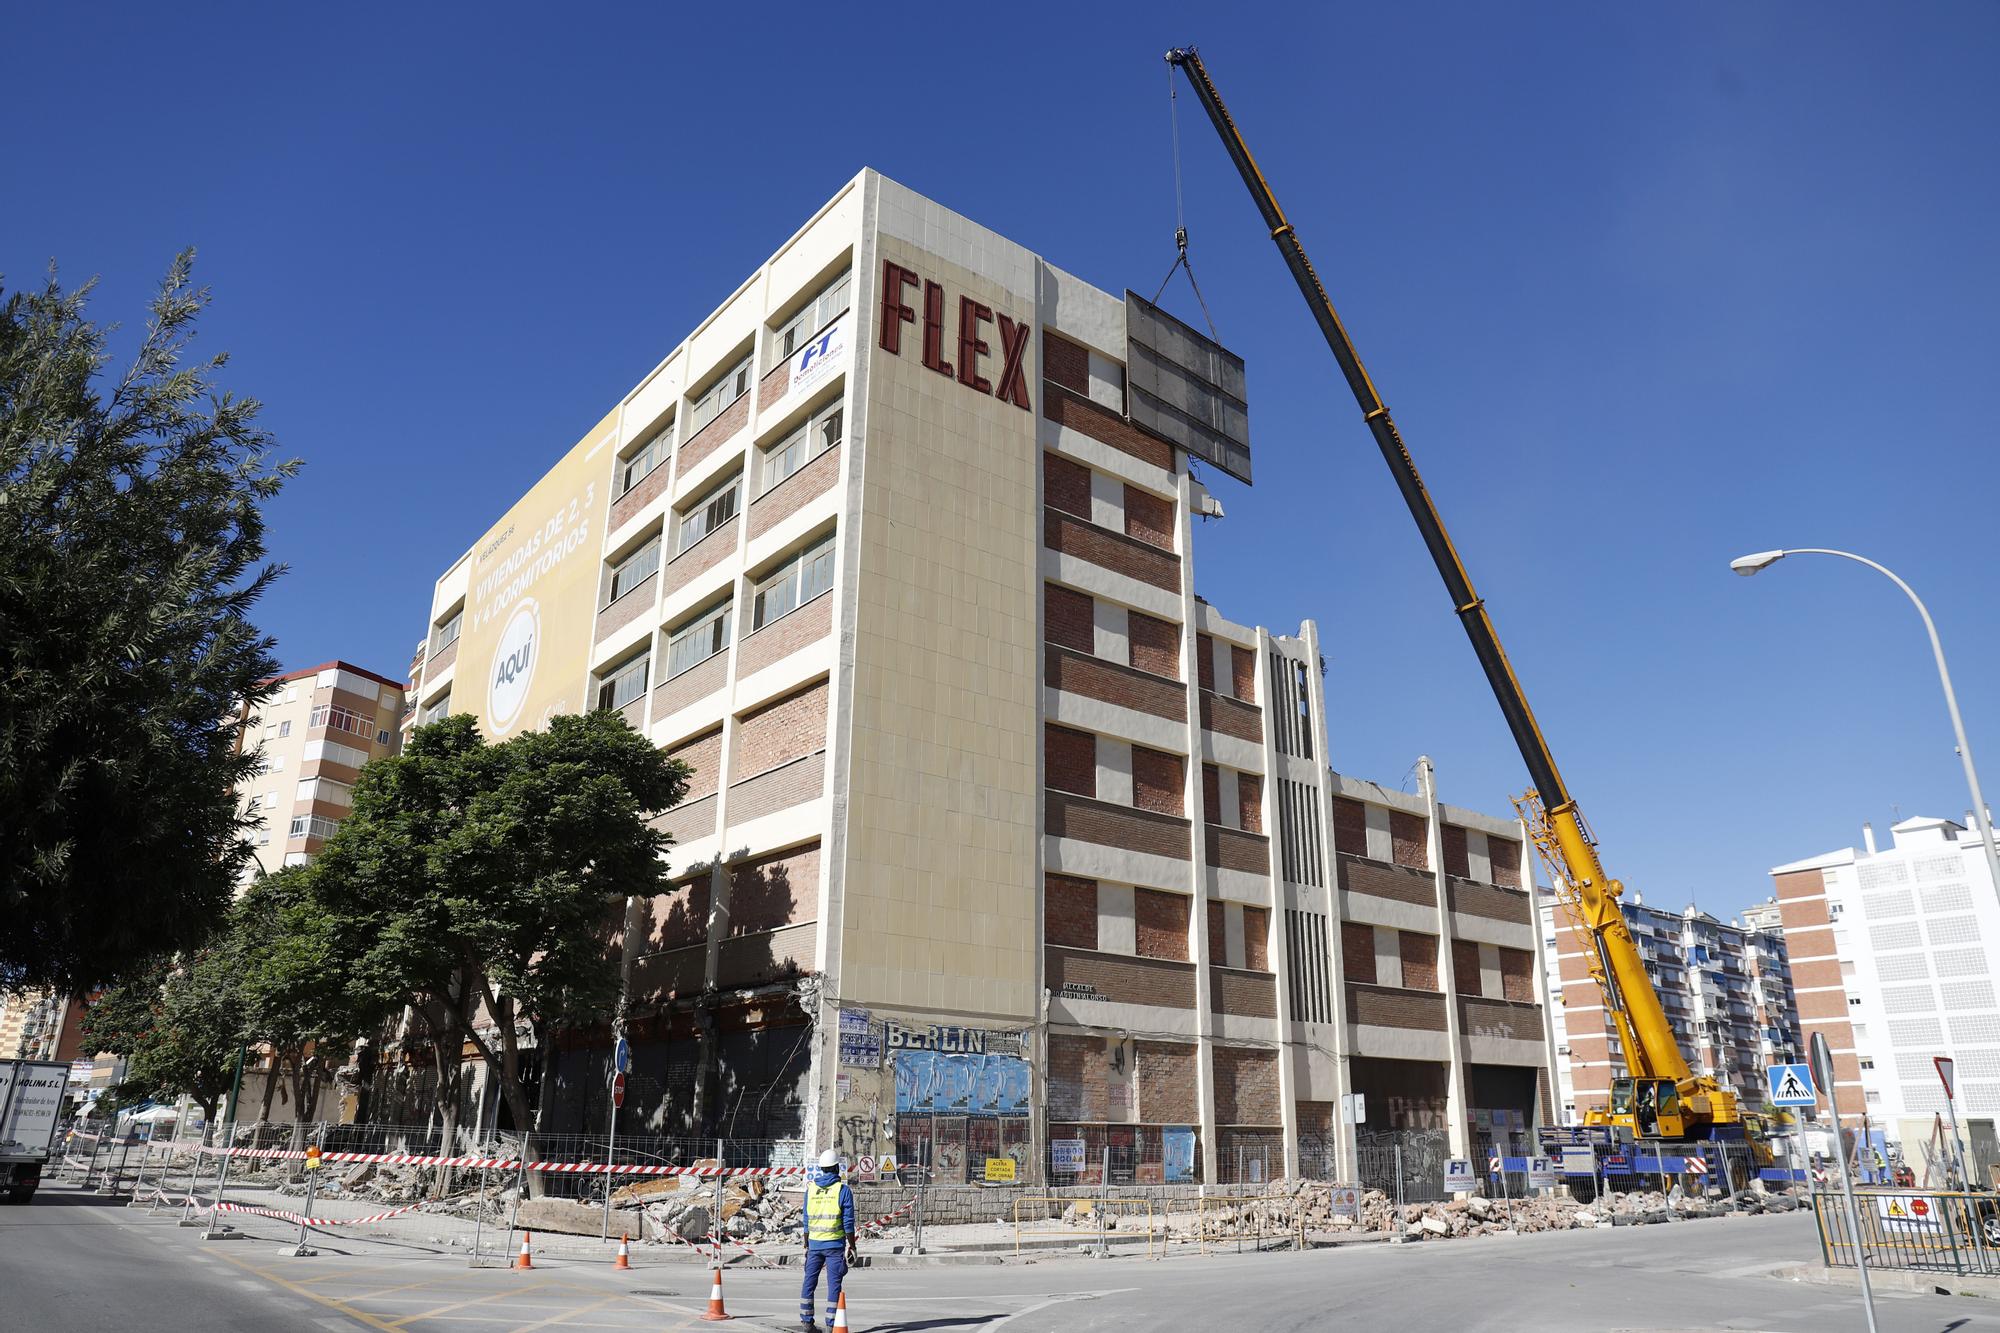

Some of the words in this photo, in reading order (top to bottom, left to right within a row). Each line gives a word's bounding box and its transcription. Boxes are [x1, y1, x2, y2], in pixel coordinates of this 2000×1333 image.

[799, 326, 838, 372] FT
[879, 259, 1031, 411] FLEX
[475, 526, 542, 603] VIVIENDAS
[544, 510, 563, 539] DE
[567, 500, 580, 522] 2,
[585, 481, 595, 506] 3
[473, 611, 481, 632] Y
[483, 604, 491, 623] 4
[493, 518, 590, 622] DORMITORIOS
[495, 633, 533, 690] AQUÍ
[1063, 982, 1094, 992] ALCALDE
[887, 1022, 984, 1053] BERLIN
[47, 1080, 61, 1089] S.L.
[615, 1085, 625, 1095] STOP
[1450, 1161, 1468, 1175] FT
[1533, 1159, 1549, 1171] FT
